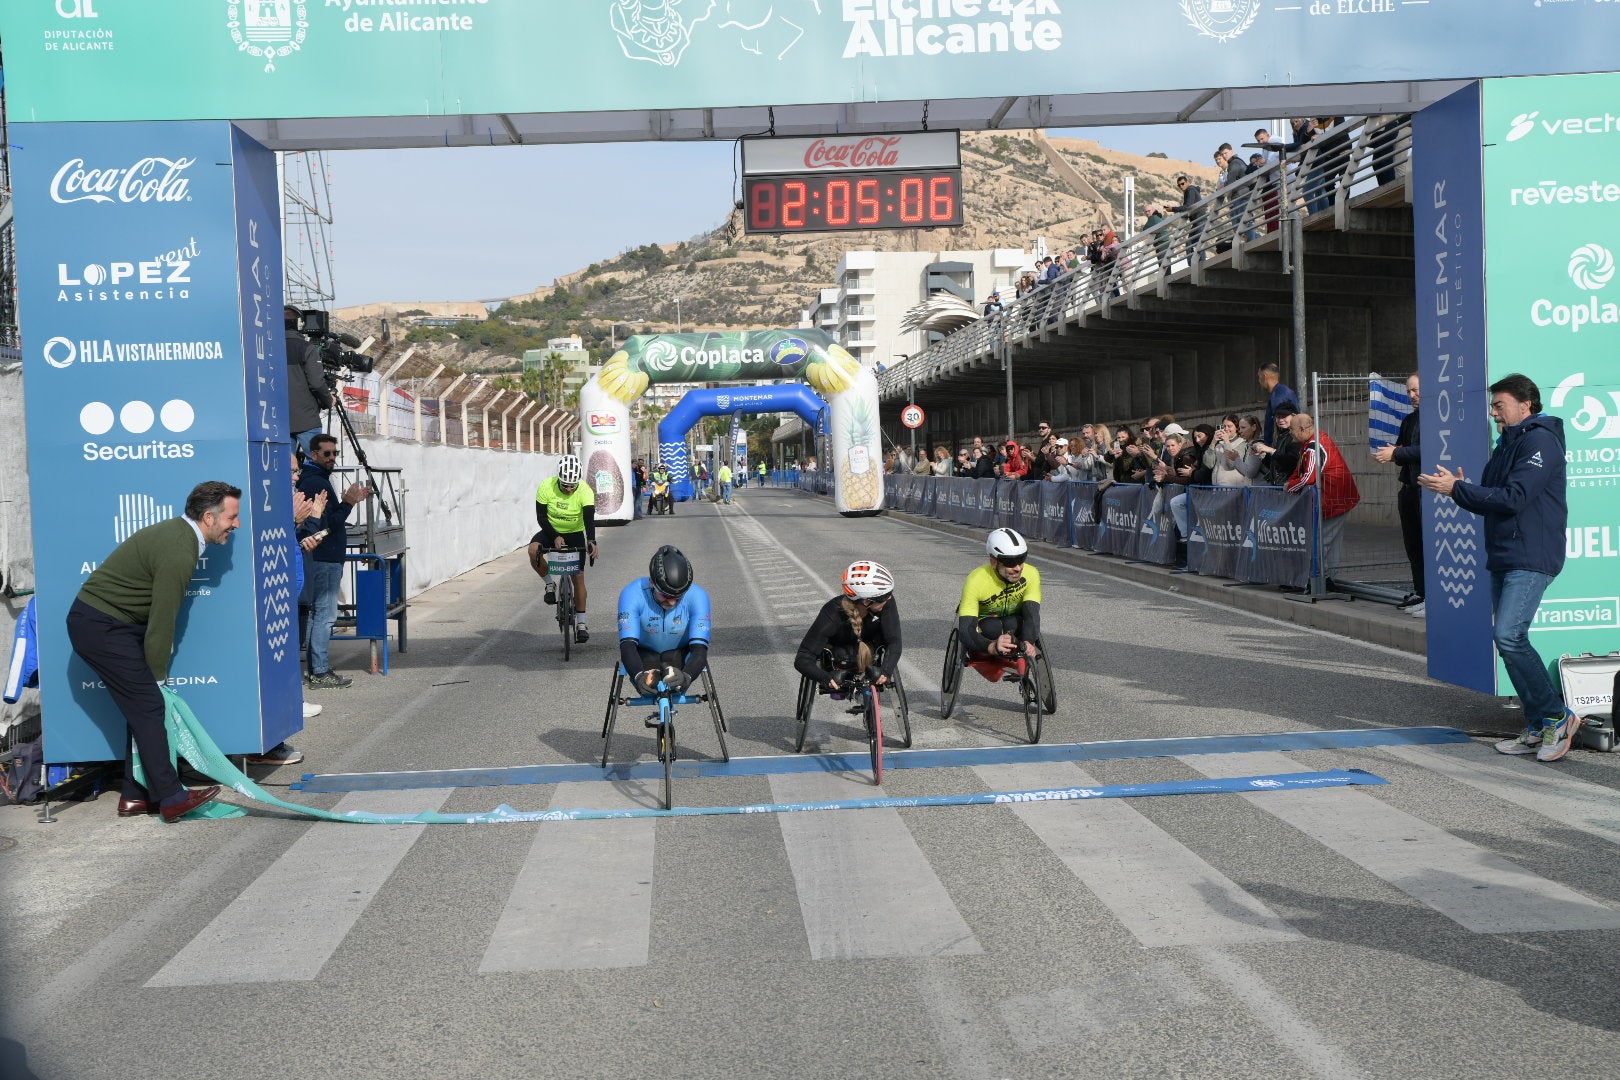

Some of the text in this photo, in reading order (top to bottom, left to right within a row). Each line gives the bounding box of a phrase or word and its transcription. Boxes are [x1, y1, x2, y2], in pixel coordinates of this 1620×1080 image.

[1309, 0, 1396, 15] de ELCHE
[44, 28, 113, 39] DIPUTACIÓN
[344, 12, 473, 33] de Alicante
[842, 8, 1063, 59] Alicante
[45, 41, 114, 51] DE ALICANTE
[1541, 113, 1620, 136] vect
[57, 286, 190, 302] Asistencia
[1433, 178, 1452, 462] MONTEMAR
[1530, 295, 1620, 333] Copla
[79, 339, 223, 363] HLA VISTAHERMOSA
[680, 345, 765, 370] Coplaca
[249, 217, 272, 512] MONTEMAR
[1457, 355, 1465, 423] CLUB
[906, 412, 920, 421] 30
[83, 440, 195, 461] Securitas
[1257, 519, 1307, 545] Alicante
[549, 564, 580, 572] HAND-BIKE
[1574, 695, 1614, 705] TS2P8-13
